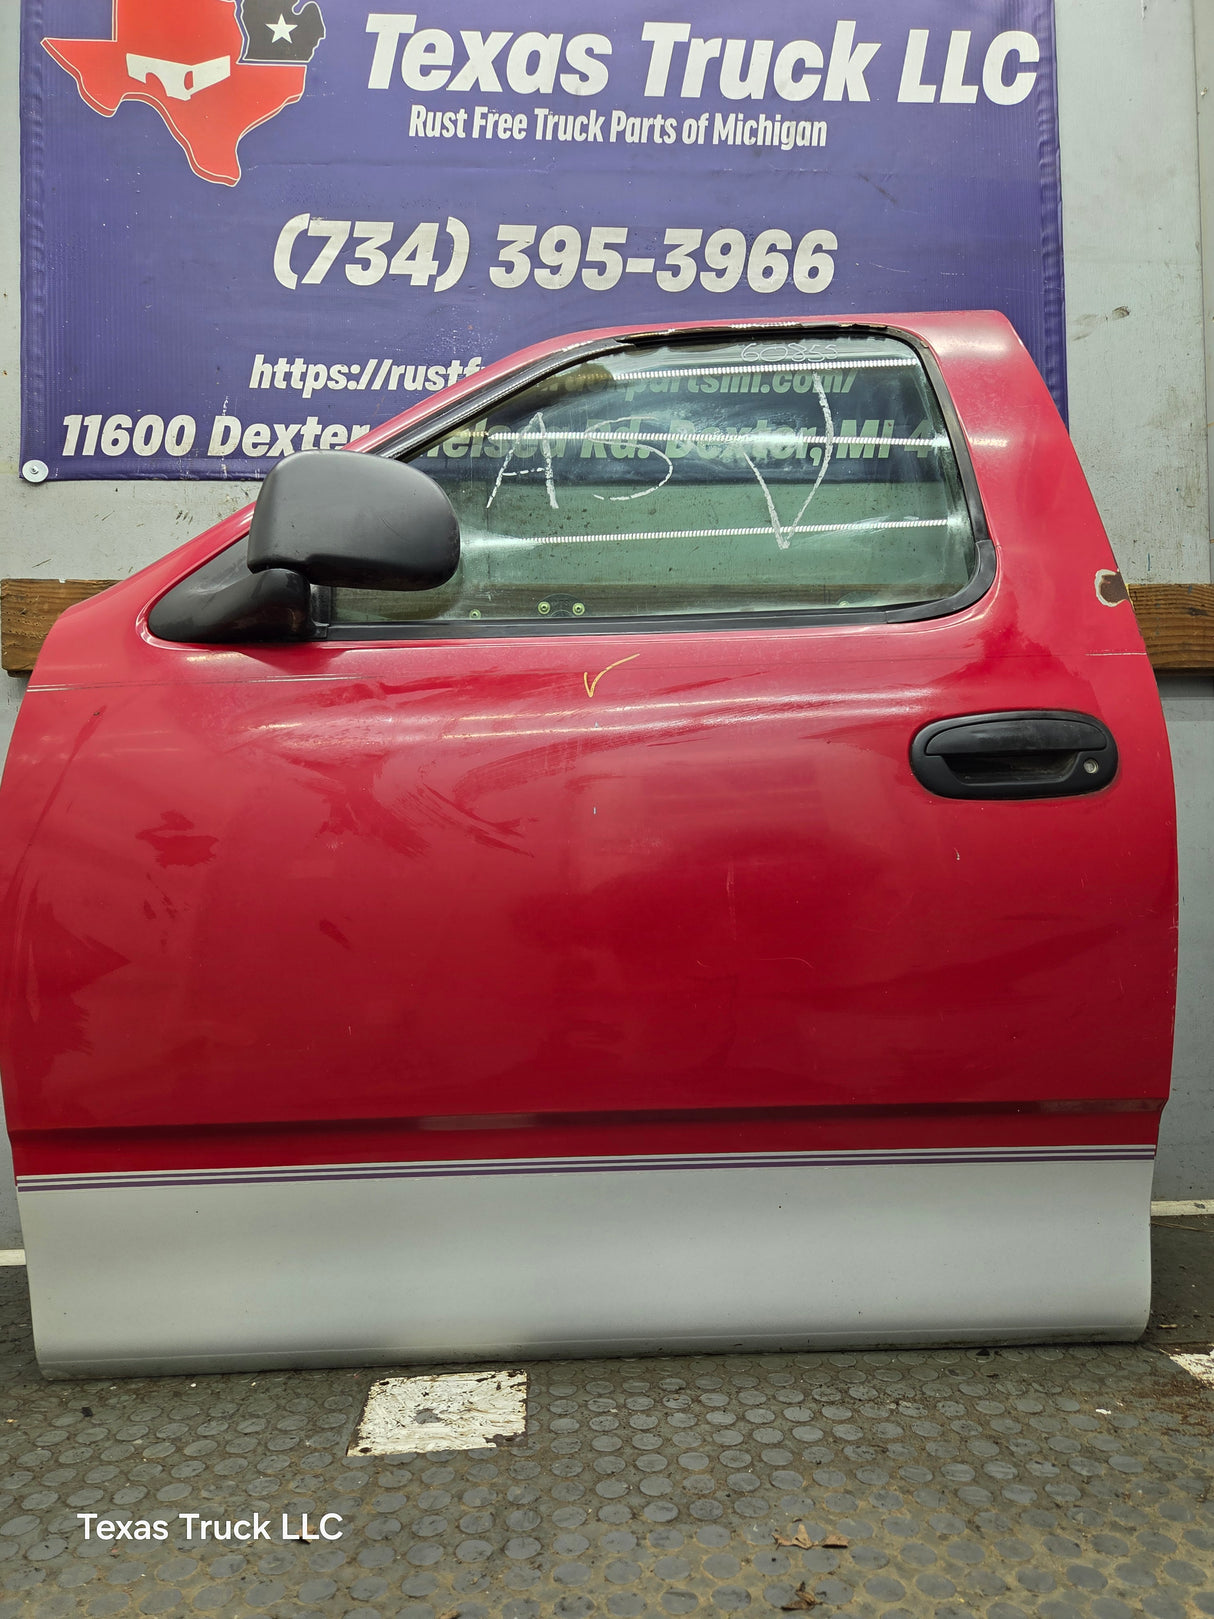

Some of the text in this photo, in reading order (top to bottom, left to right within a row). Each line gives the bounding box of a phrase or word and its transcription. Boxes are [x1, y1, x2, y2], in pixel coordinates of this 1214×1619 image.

[364, 13, 1040, 106] Texas Truck LLC
[409, 104, 828, 151] Rust Free Truck Parts of Michigan
[273, 213, 838, 294] (734) 395-3966
[62, 414, 196, 457] 11600
[580, 418, 650, 459] Rd.
[836, 419, 895, 459] MI
